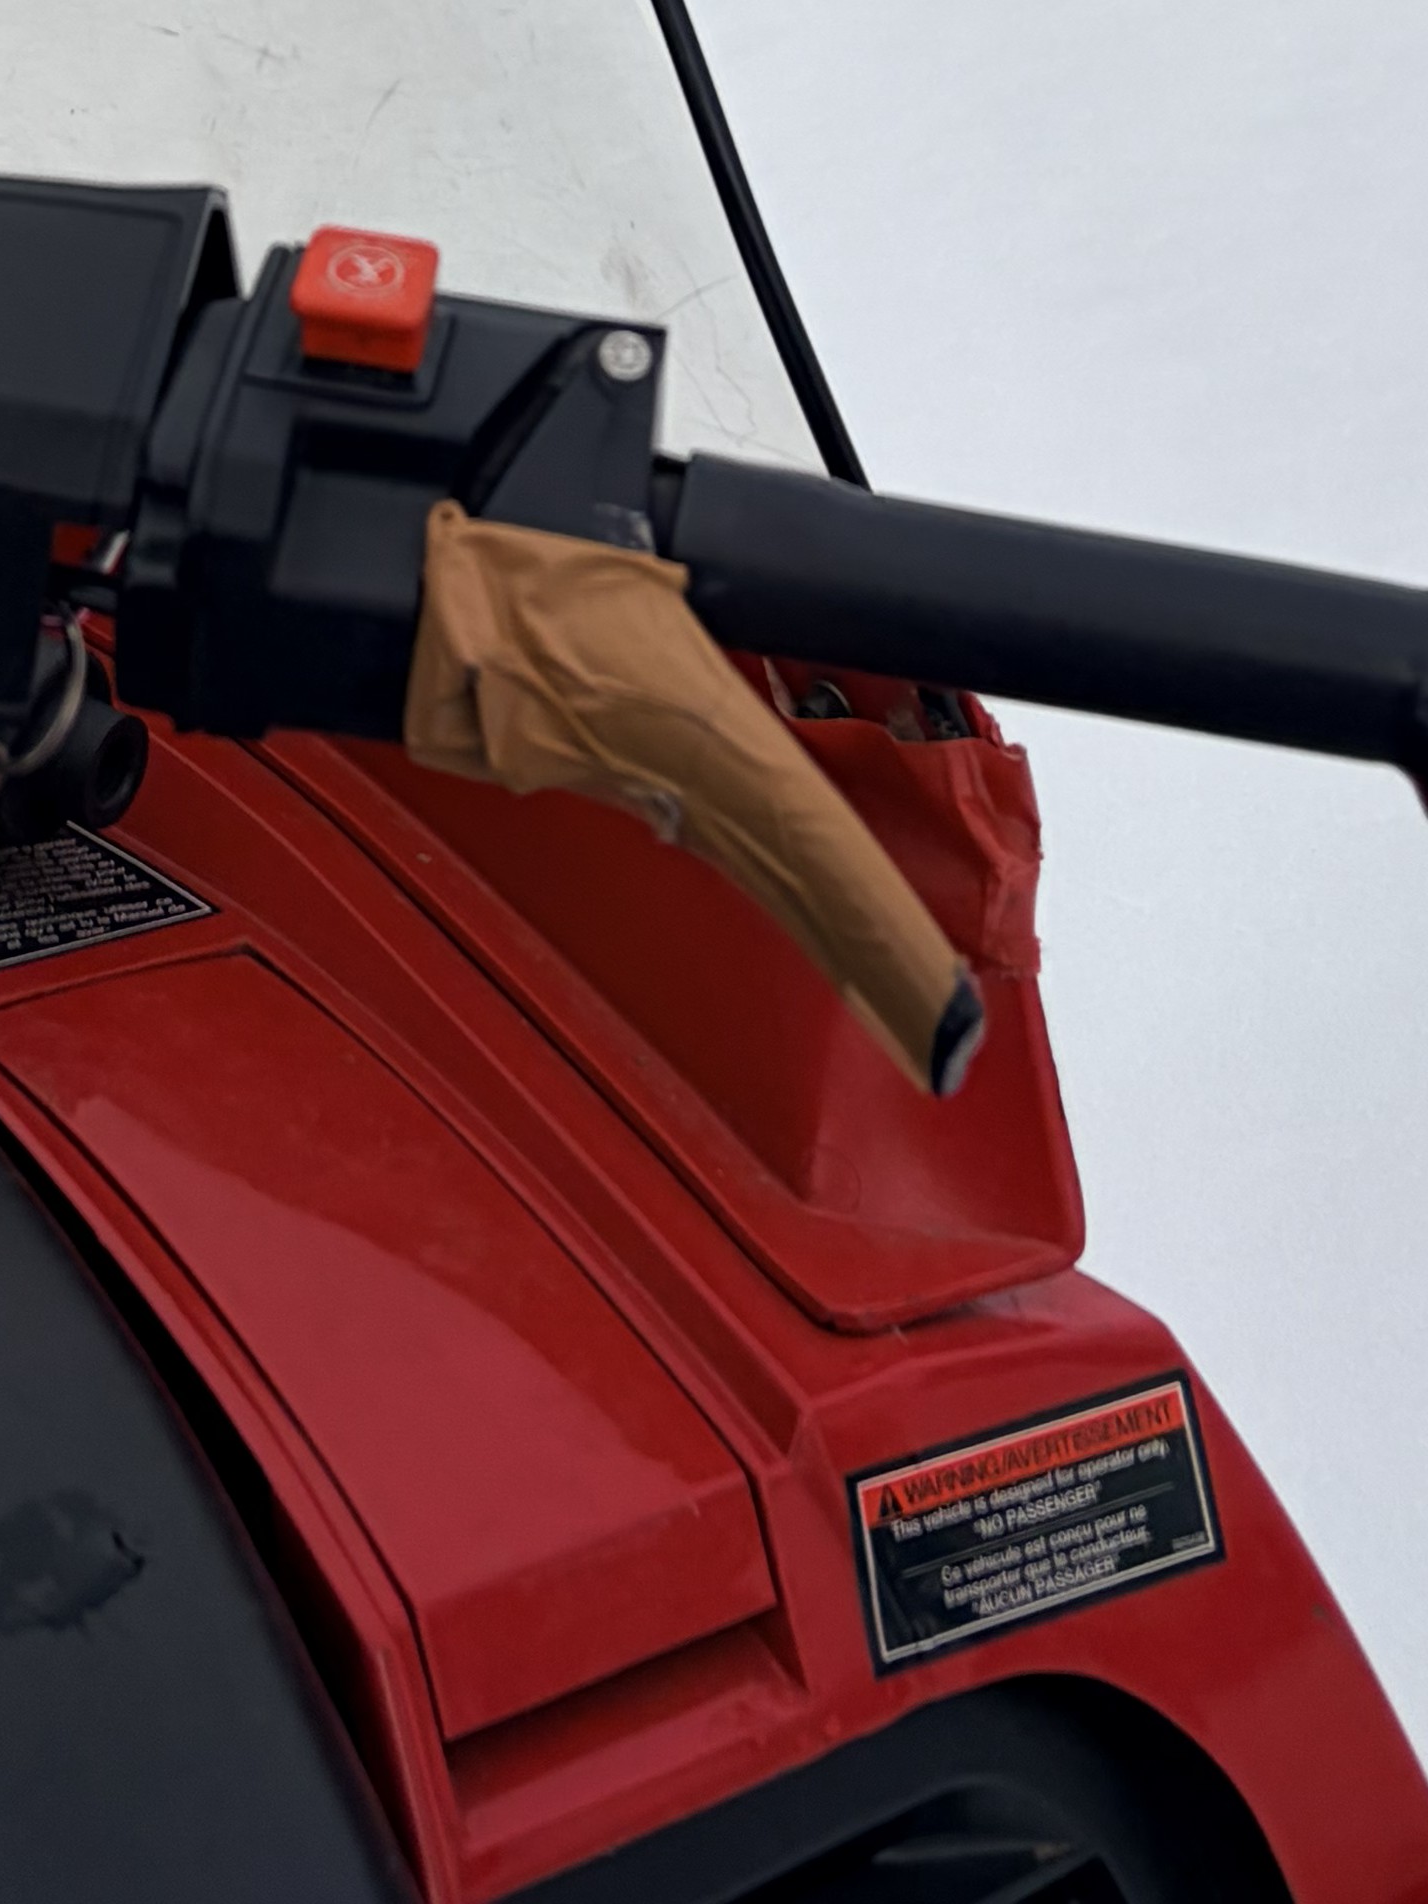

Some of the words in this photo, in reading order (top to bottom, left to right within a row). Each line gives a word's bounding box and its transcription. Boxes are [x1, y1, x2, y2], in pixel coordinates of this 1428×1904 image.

[891, 1516, 922, 1541] This
[923, 1500, 972, 1531] vehicle
[974, 1495, 987, 1511] is
[1025, 1534, 1048, 1559] est
[1129, 1503, 1148, 1524] ne
